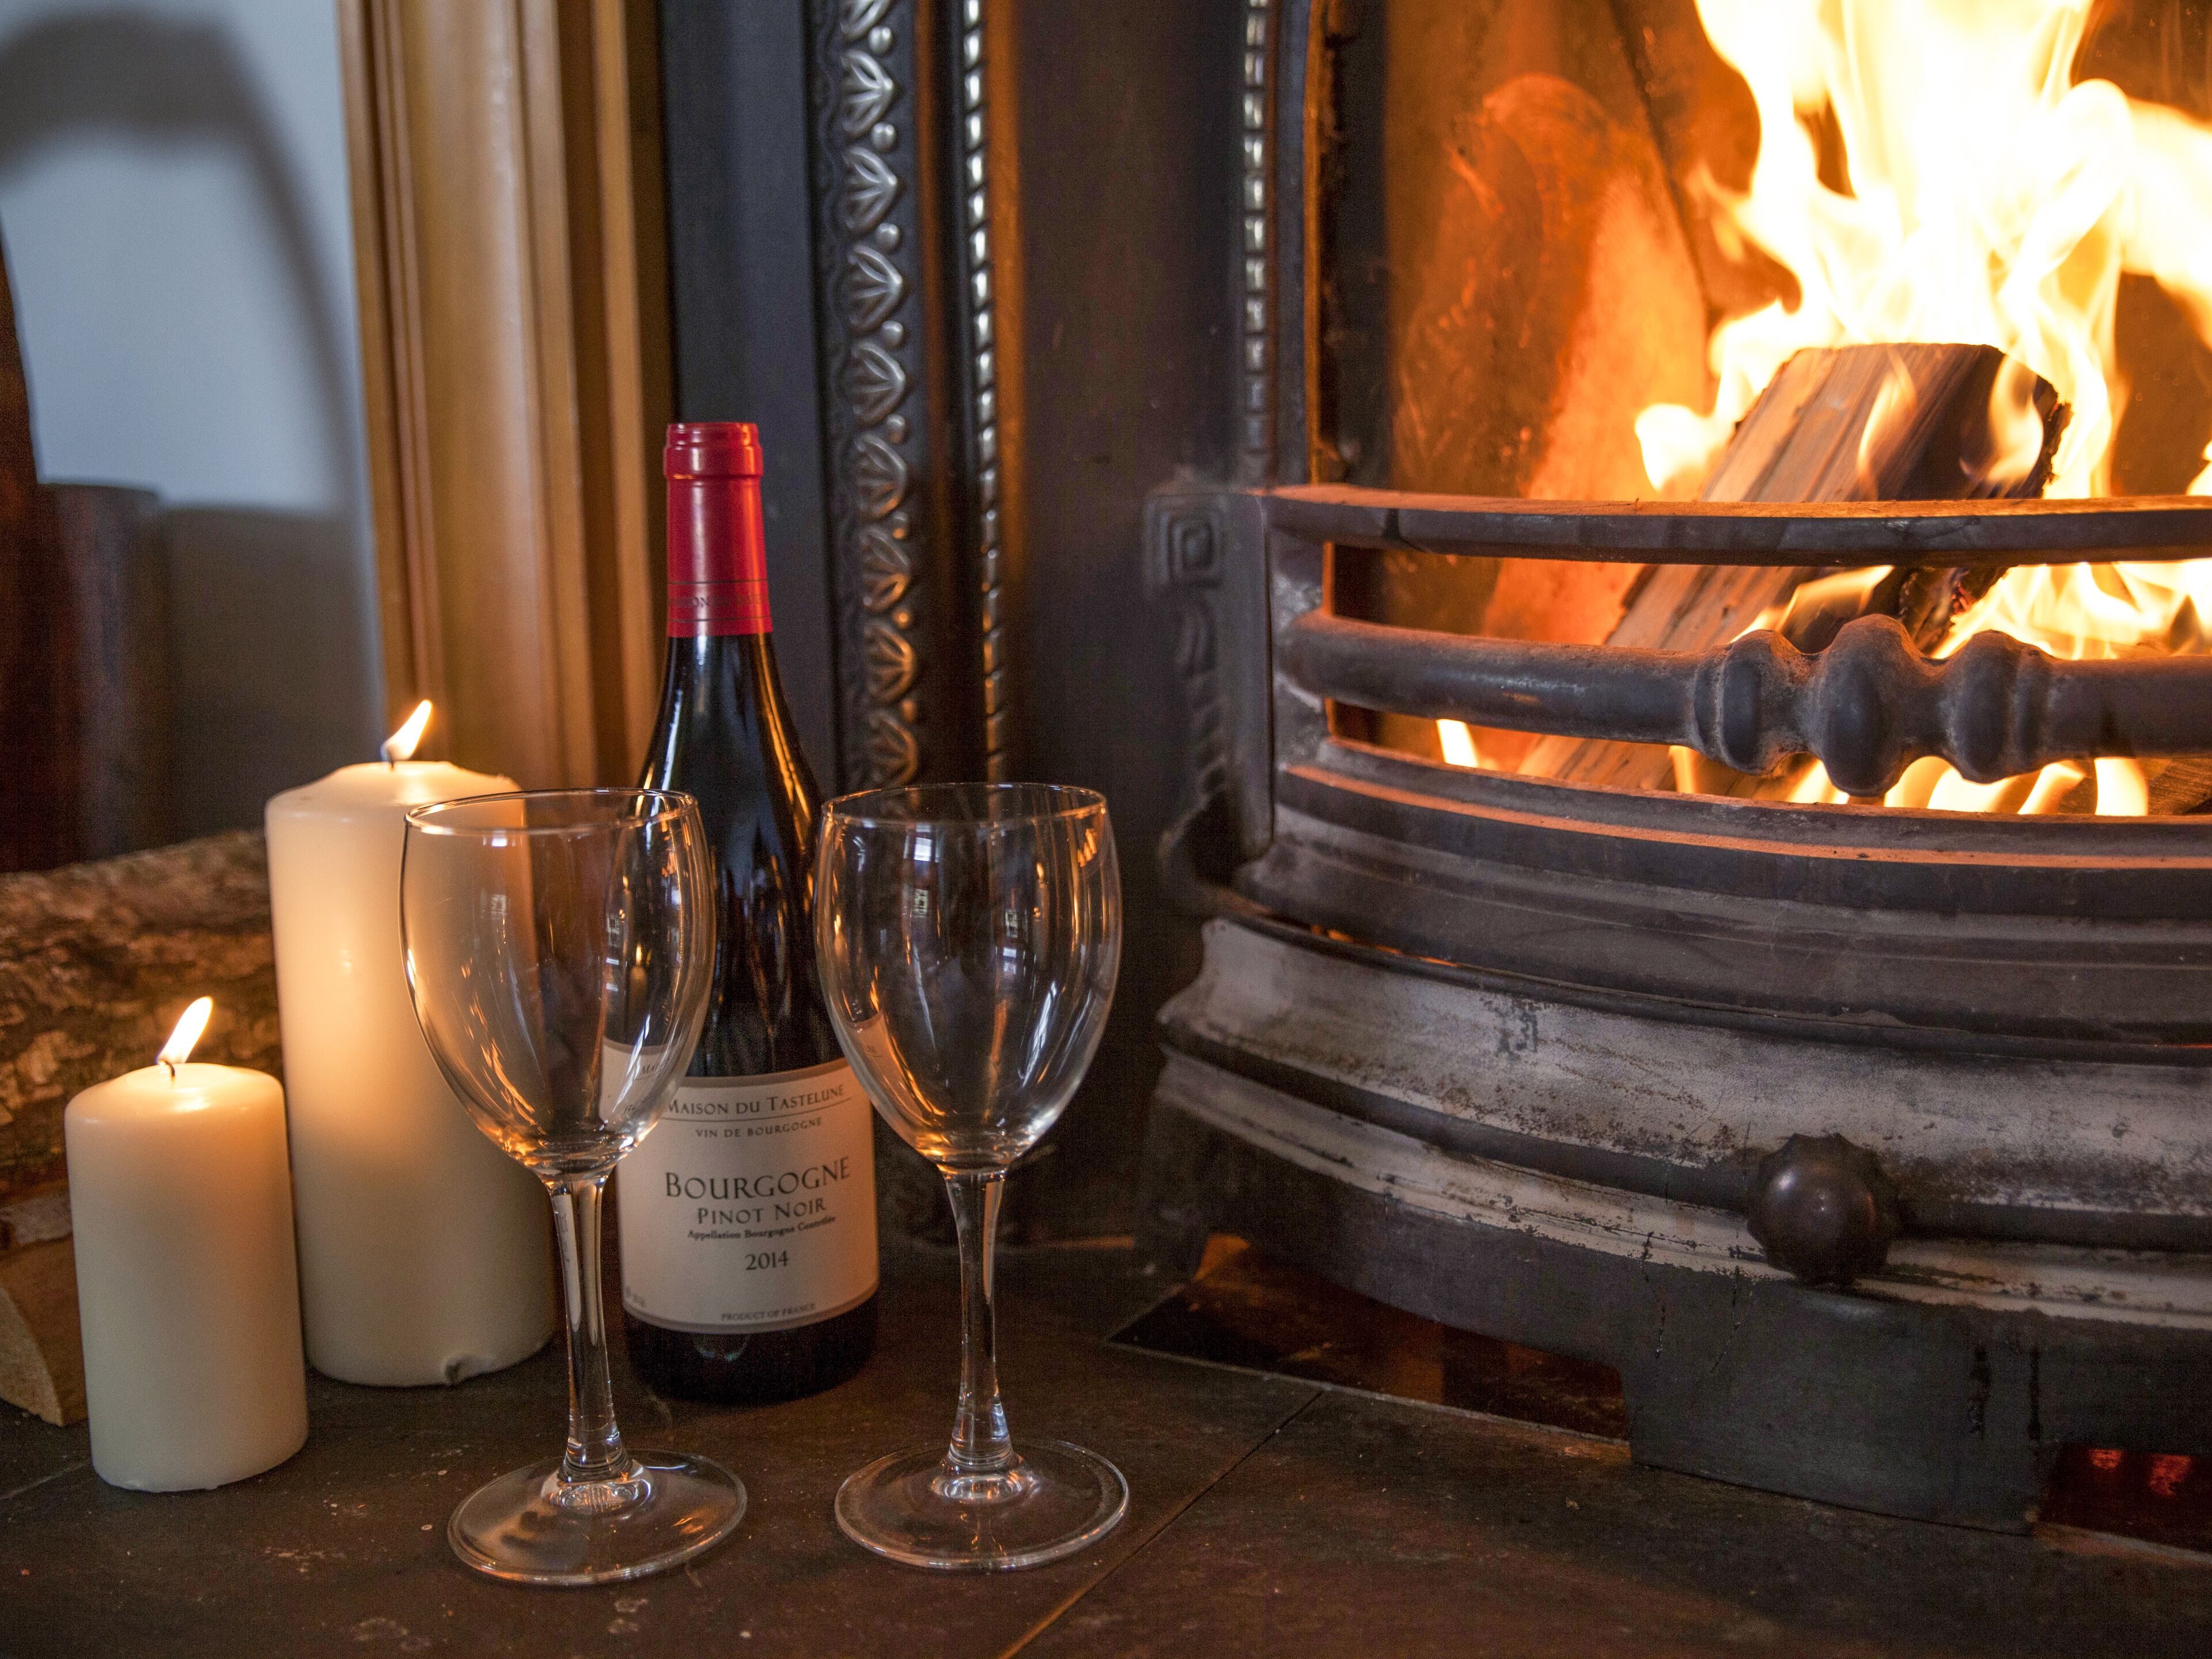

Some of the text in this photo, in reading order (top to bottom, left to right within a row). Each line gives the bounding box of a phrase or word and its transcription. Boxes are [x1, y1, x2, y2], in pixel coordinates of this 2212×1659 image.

[668, 1099, 729, 1115] MAISON
[736, 1101, 760, 1114] DU
[695, 1117, 821, 1138] VIN DE BOURGOGNE
[665, 1156, 850, 1199] BOURGOGNE
[698, 1198, 826, 1224] PINOT NOIR
[745, 1250, 789, 1270] 2014
